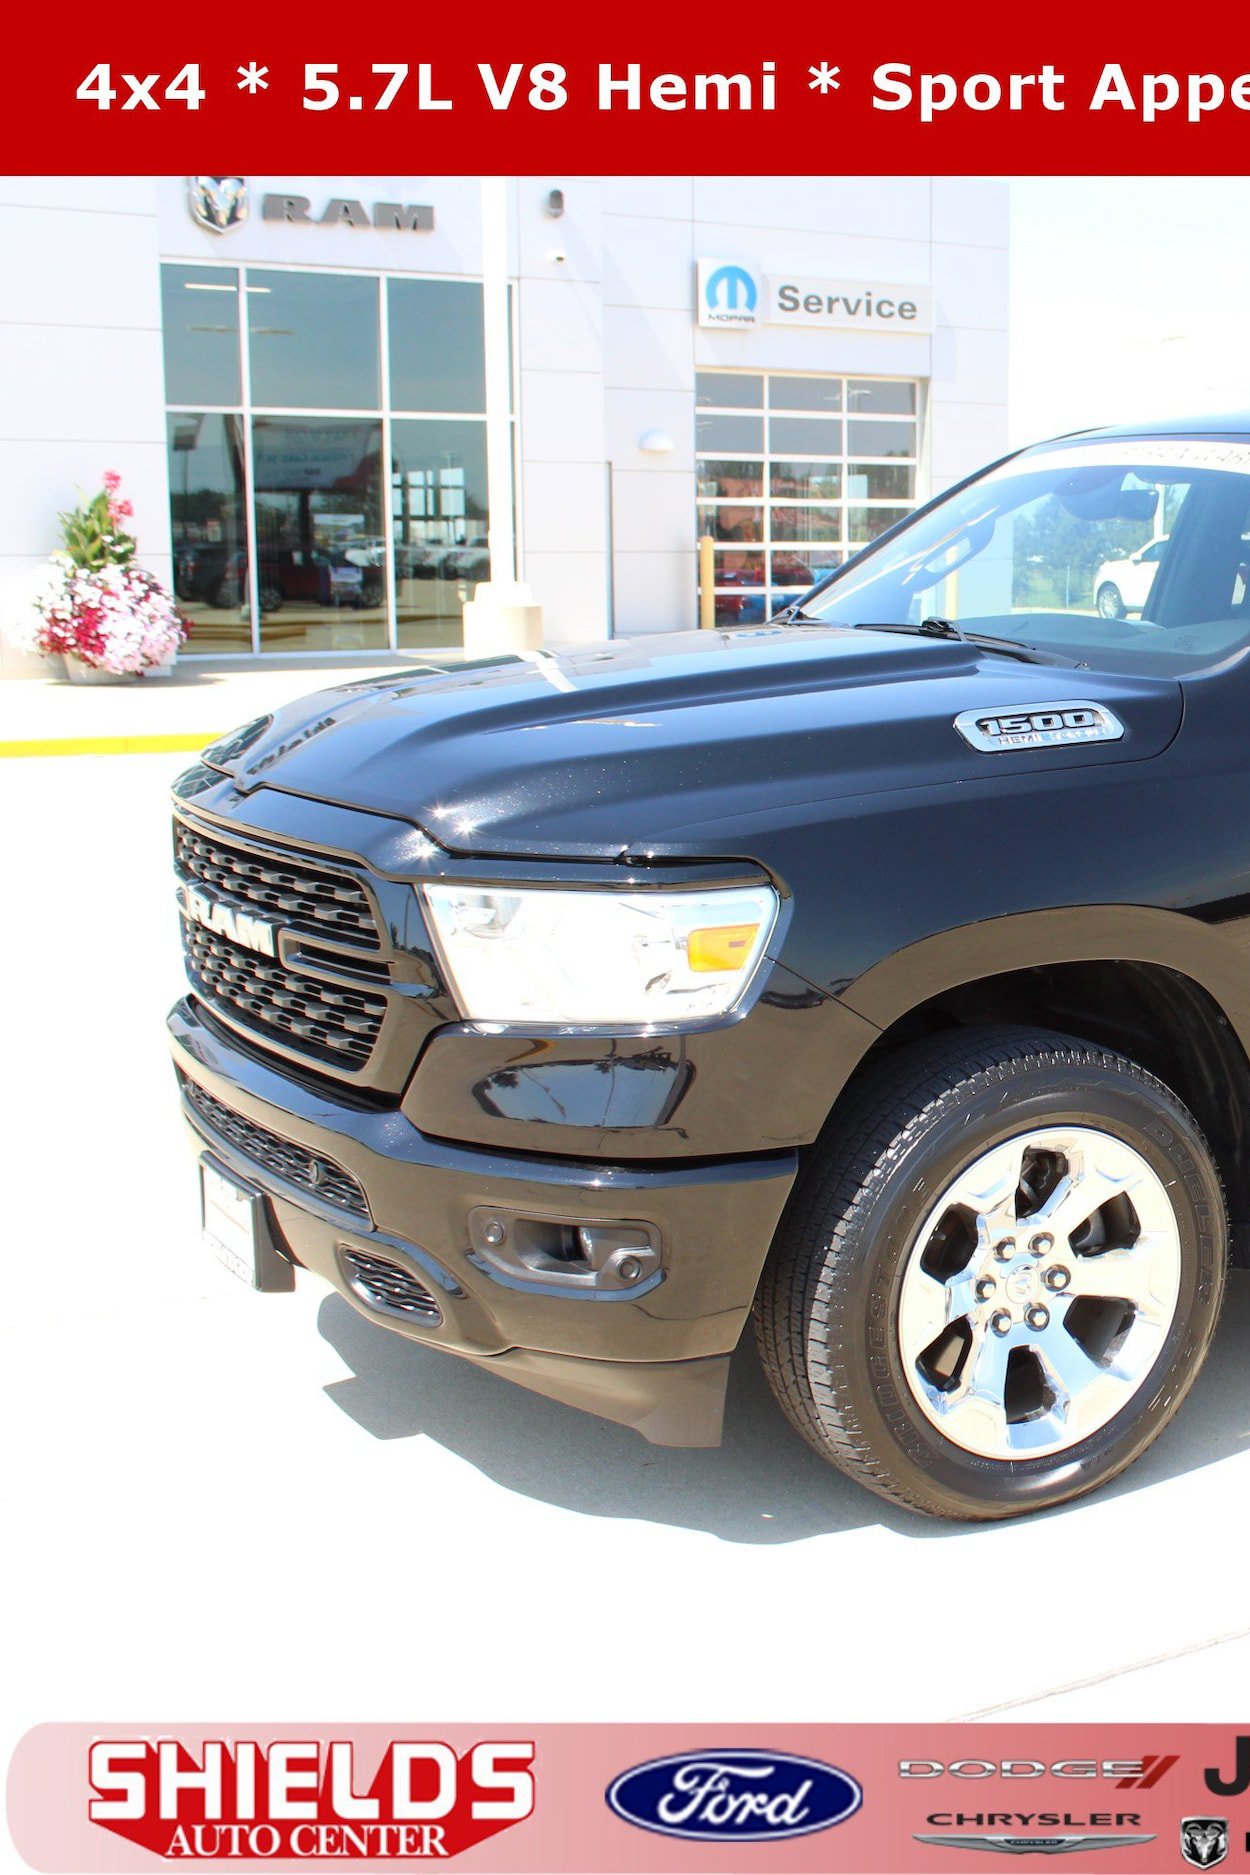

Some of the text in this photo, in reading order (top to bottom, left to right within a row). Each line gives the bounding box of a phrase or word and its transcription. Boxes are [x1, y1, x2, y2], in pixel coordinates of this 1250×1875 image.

[262, 193, 434, 232] RAM
[708, 313, 755, 323] MOPAR
[777, 285, 918, 321] Service
[979, 711, 1096, 737] 1500
[187, 885, 277, 958] RAM
